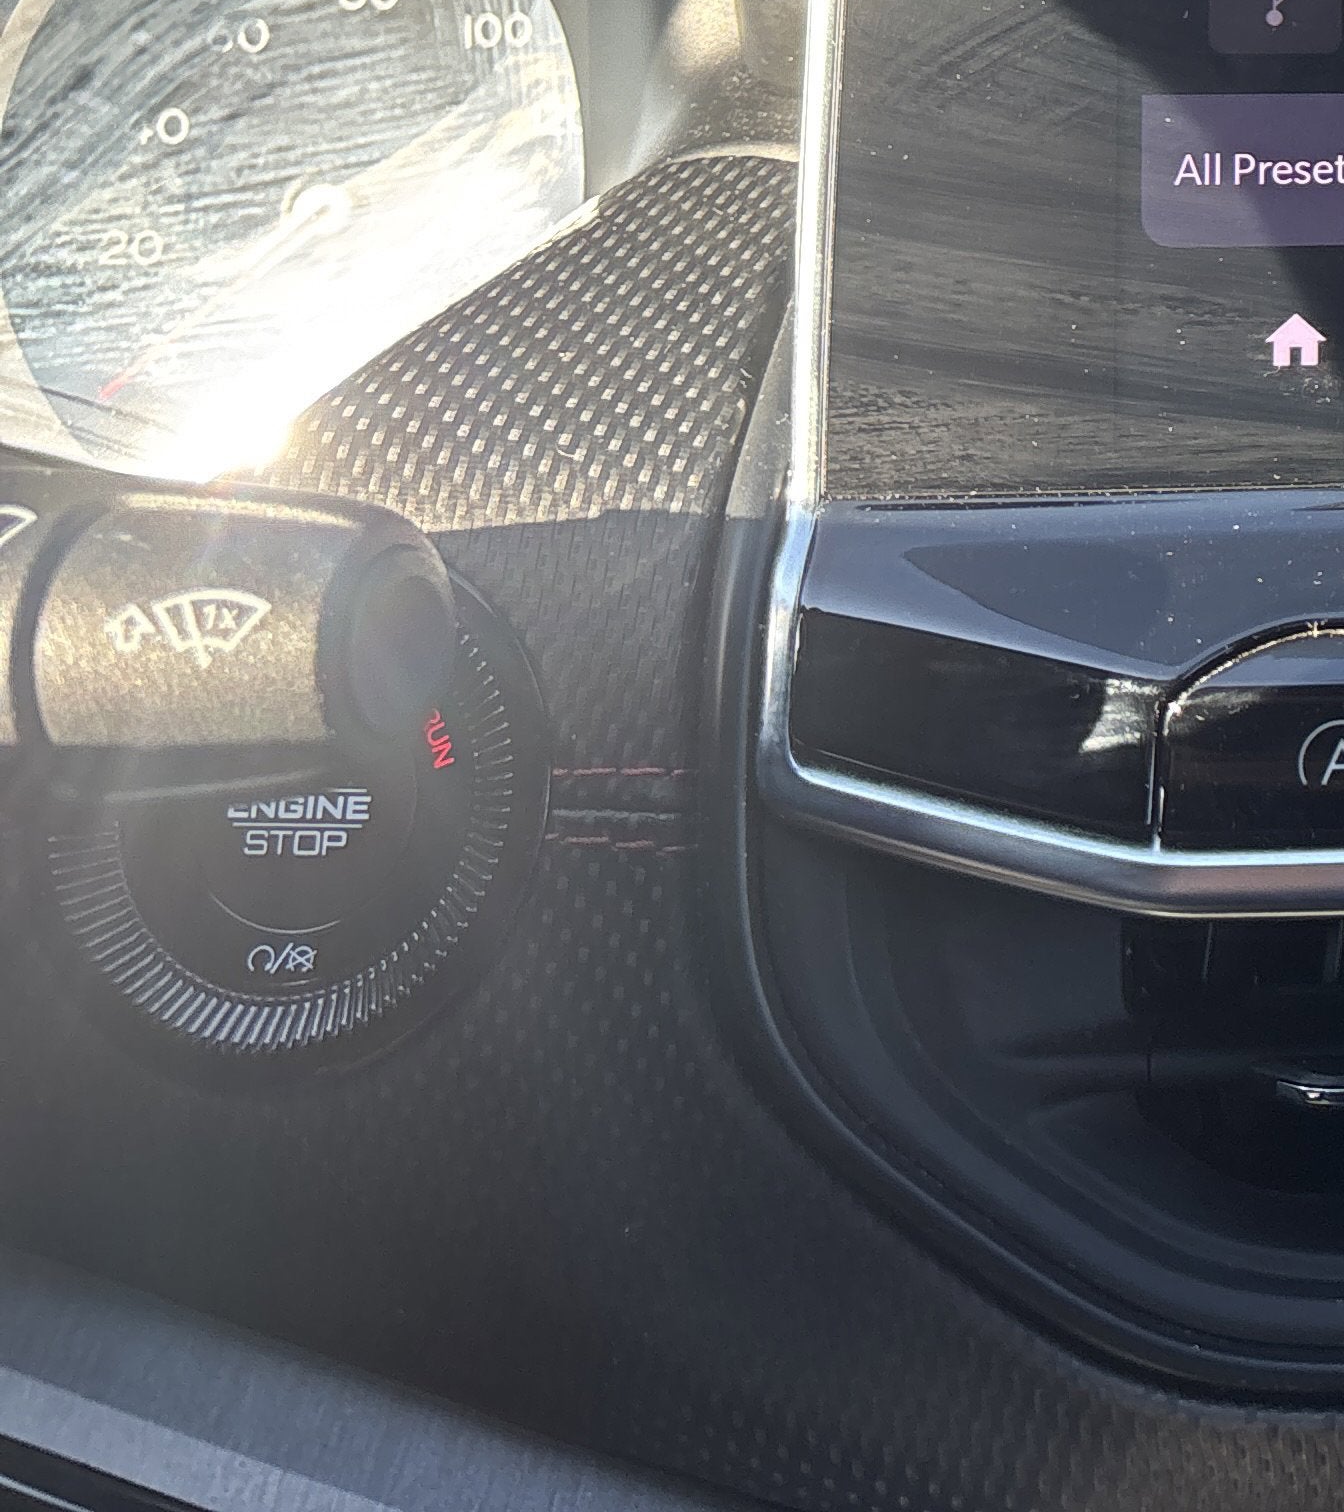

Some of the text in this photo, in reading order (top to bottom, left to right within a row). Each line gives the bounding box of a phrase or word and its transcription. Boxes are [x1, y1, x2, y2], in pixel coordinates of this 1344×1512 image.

[464, 11, 533, 50] 100
[1173, 152, 1221, 186] All
[101, 228, 164, 265] 20
[243, 829, 348, 856] STOP
